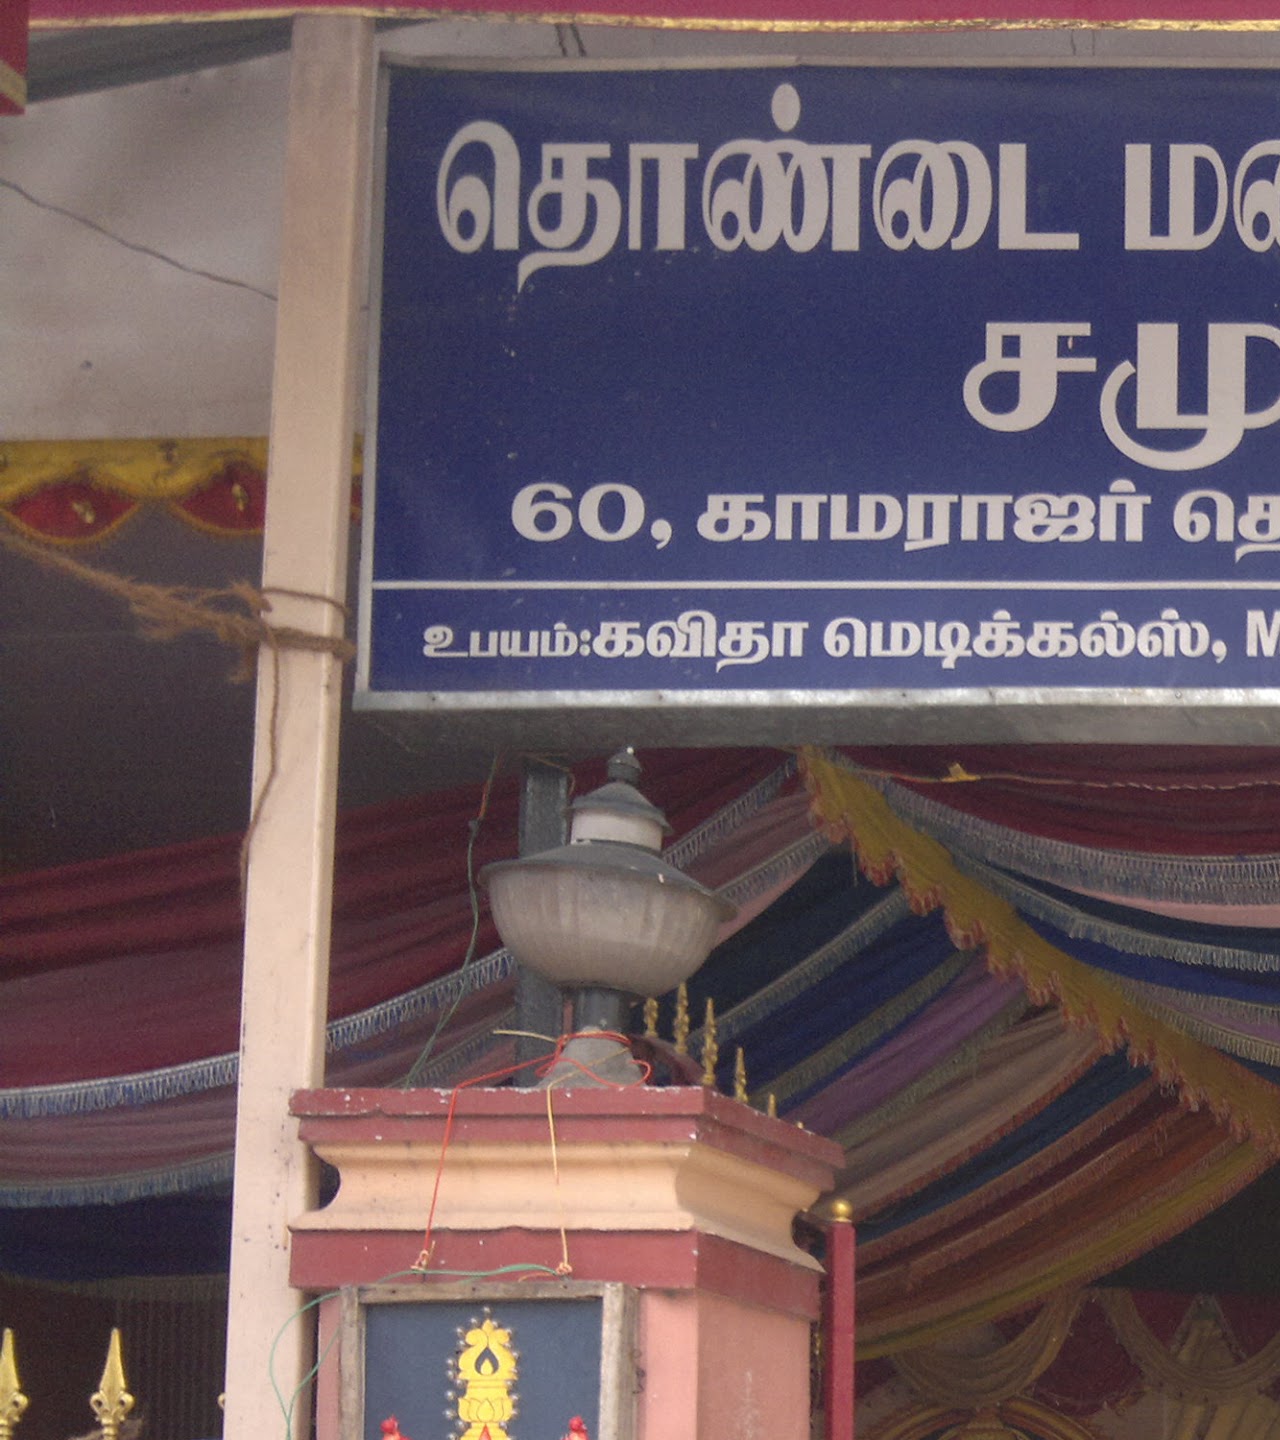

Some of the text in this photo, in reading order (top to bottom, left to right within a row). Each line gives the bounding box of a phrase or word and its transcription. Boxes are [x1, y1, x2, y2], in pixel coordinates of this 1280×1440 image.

[437, 84, 1079, 292] தொண்டை
[512, 483, 672, 549] 60,
[697, 479, 1151, 552] காமராஜர்
[823, 608, 1228, 669] மெடிக்கல்ஸ்,
